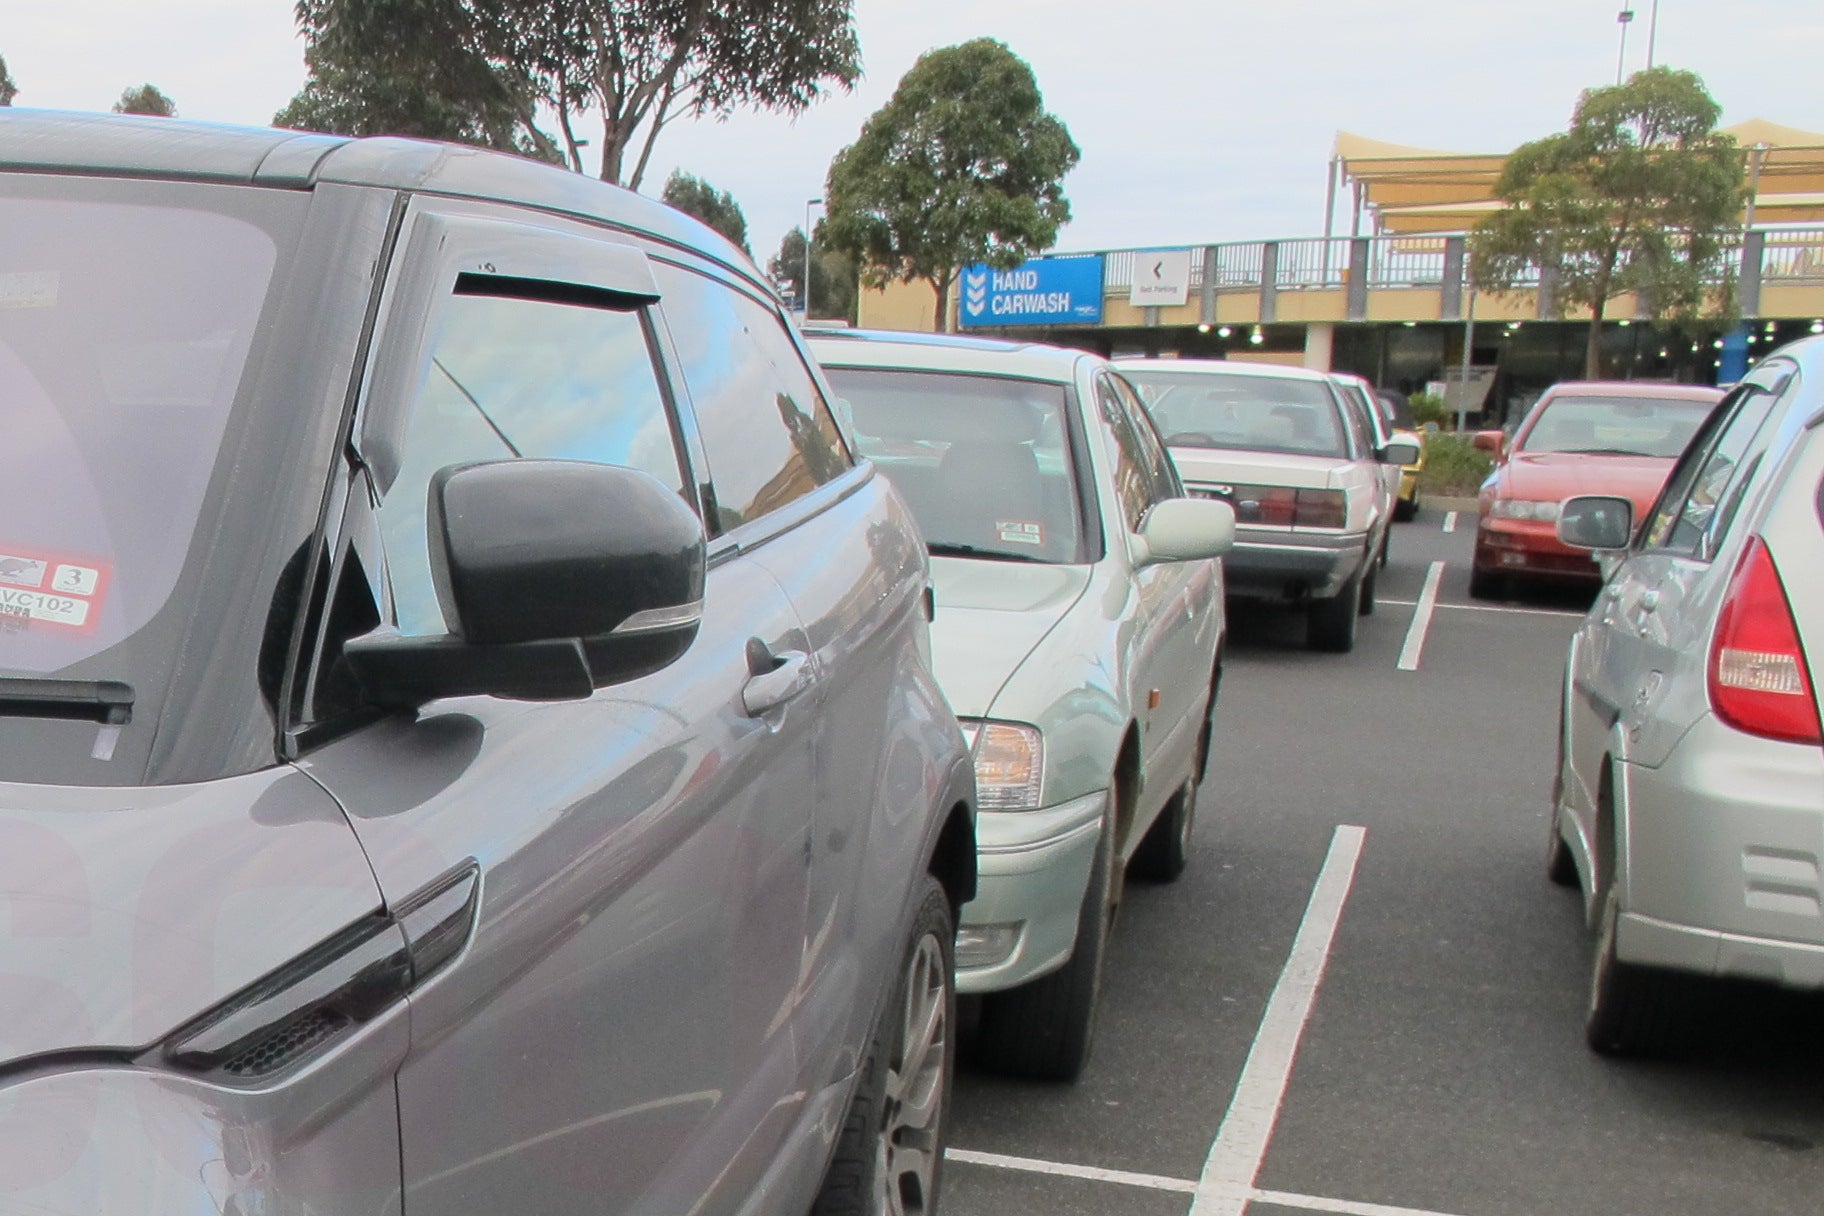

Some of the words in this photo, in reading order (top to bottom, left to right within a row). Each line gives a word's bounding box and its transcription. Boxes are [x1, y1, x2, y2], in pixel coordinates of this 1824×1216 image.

[992, 270, 1038, 292] HAND
[991, 292, 1071, 315] CARWASH
[63, 568, 82, 586] 3
